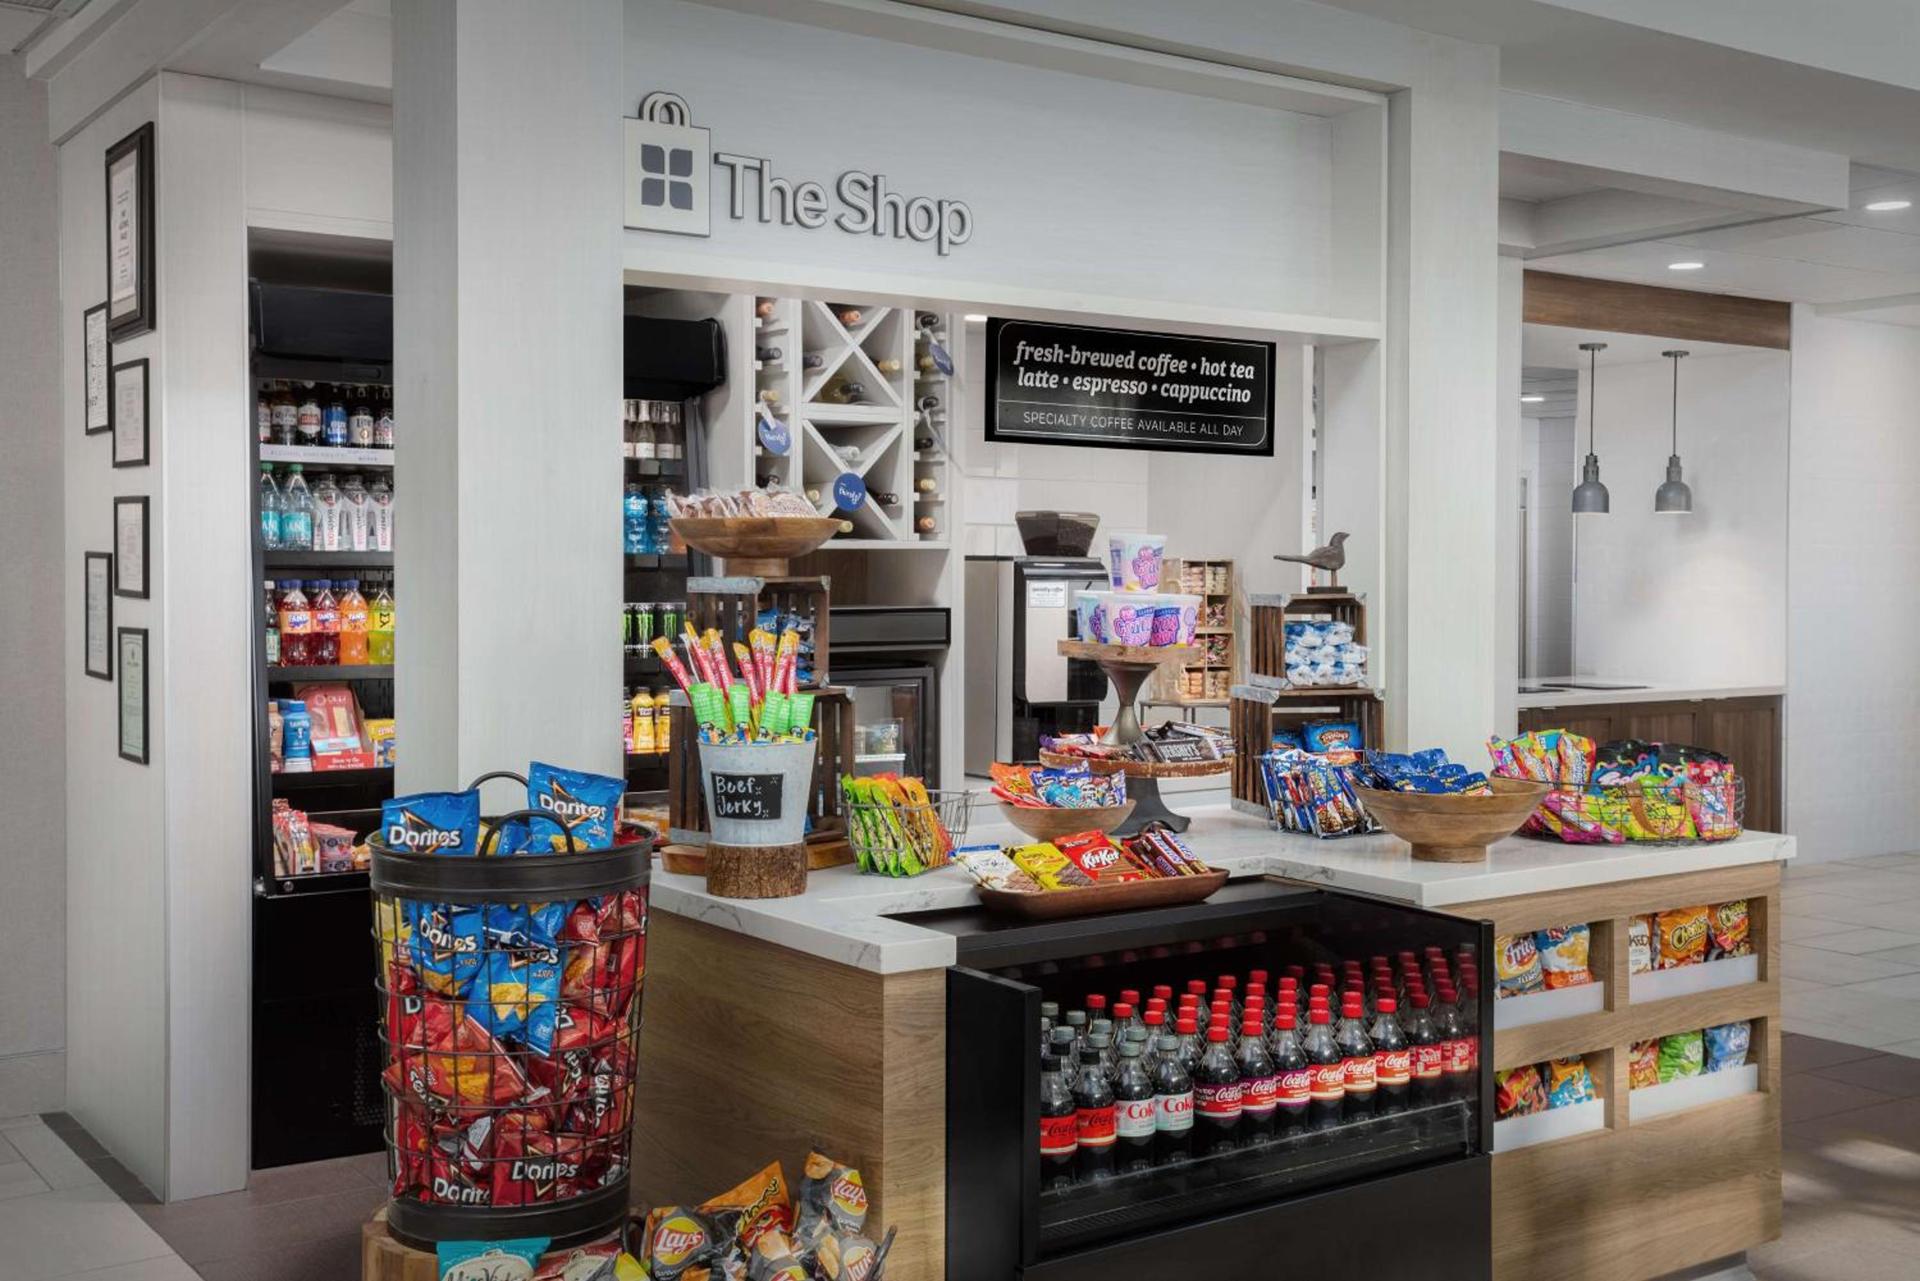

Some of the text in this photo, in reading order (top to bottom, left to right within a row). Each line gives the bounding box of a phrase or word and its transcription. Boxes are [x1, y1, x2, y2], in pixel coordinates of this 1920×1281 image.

[713, 152, 974, 256] The Shop
[1013, 341, 1255, 379] fresh-brewed coffee hot tea
[1018, 368, 1251, 403] latte espresso cappuccino
[1023, 411, 1244, 437] SPECIALTY COFFEE AVAILABLE ALL DAY
[716, 776, 756, 793] Beef
[540, 793, 607, 821] Doritos
[389, 826, 461, 847] Doritos
